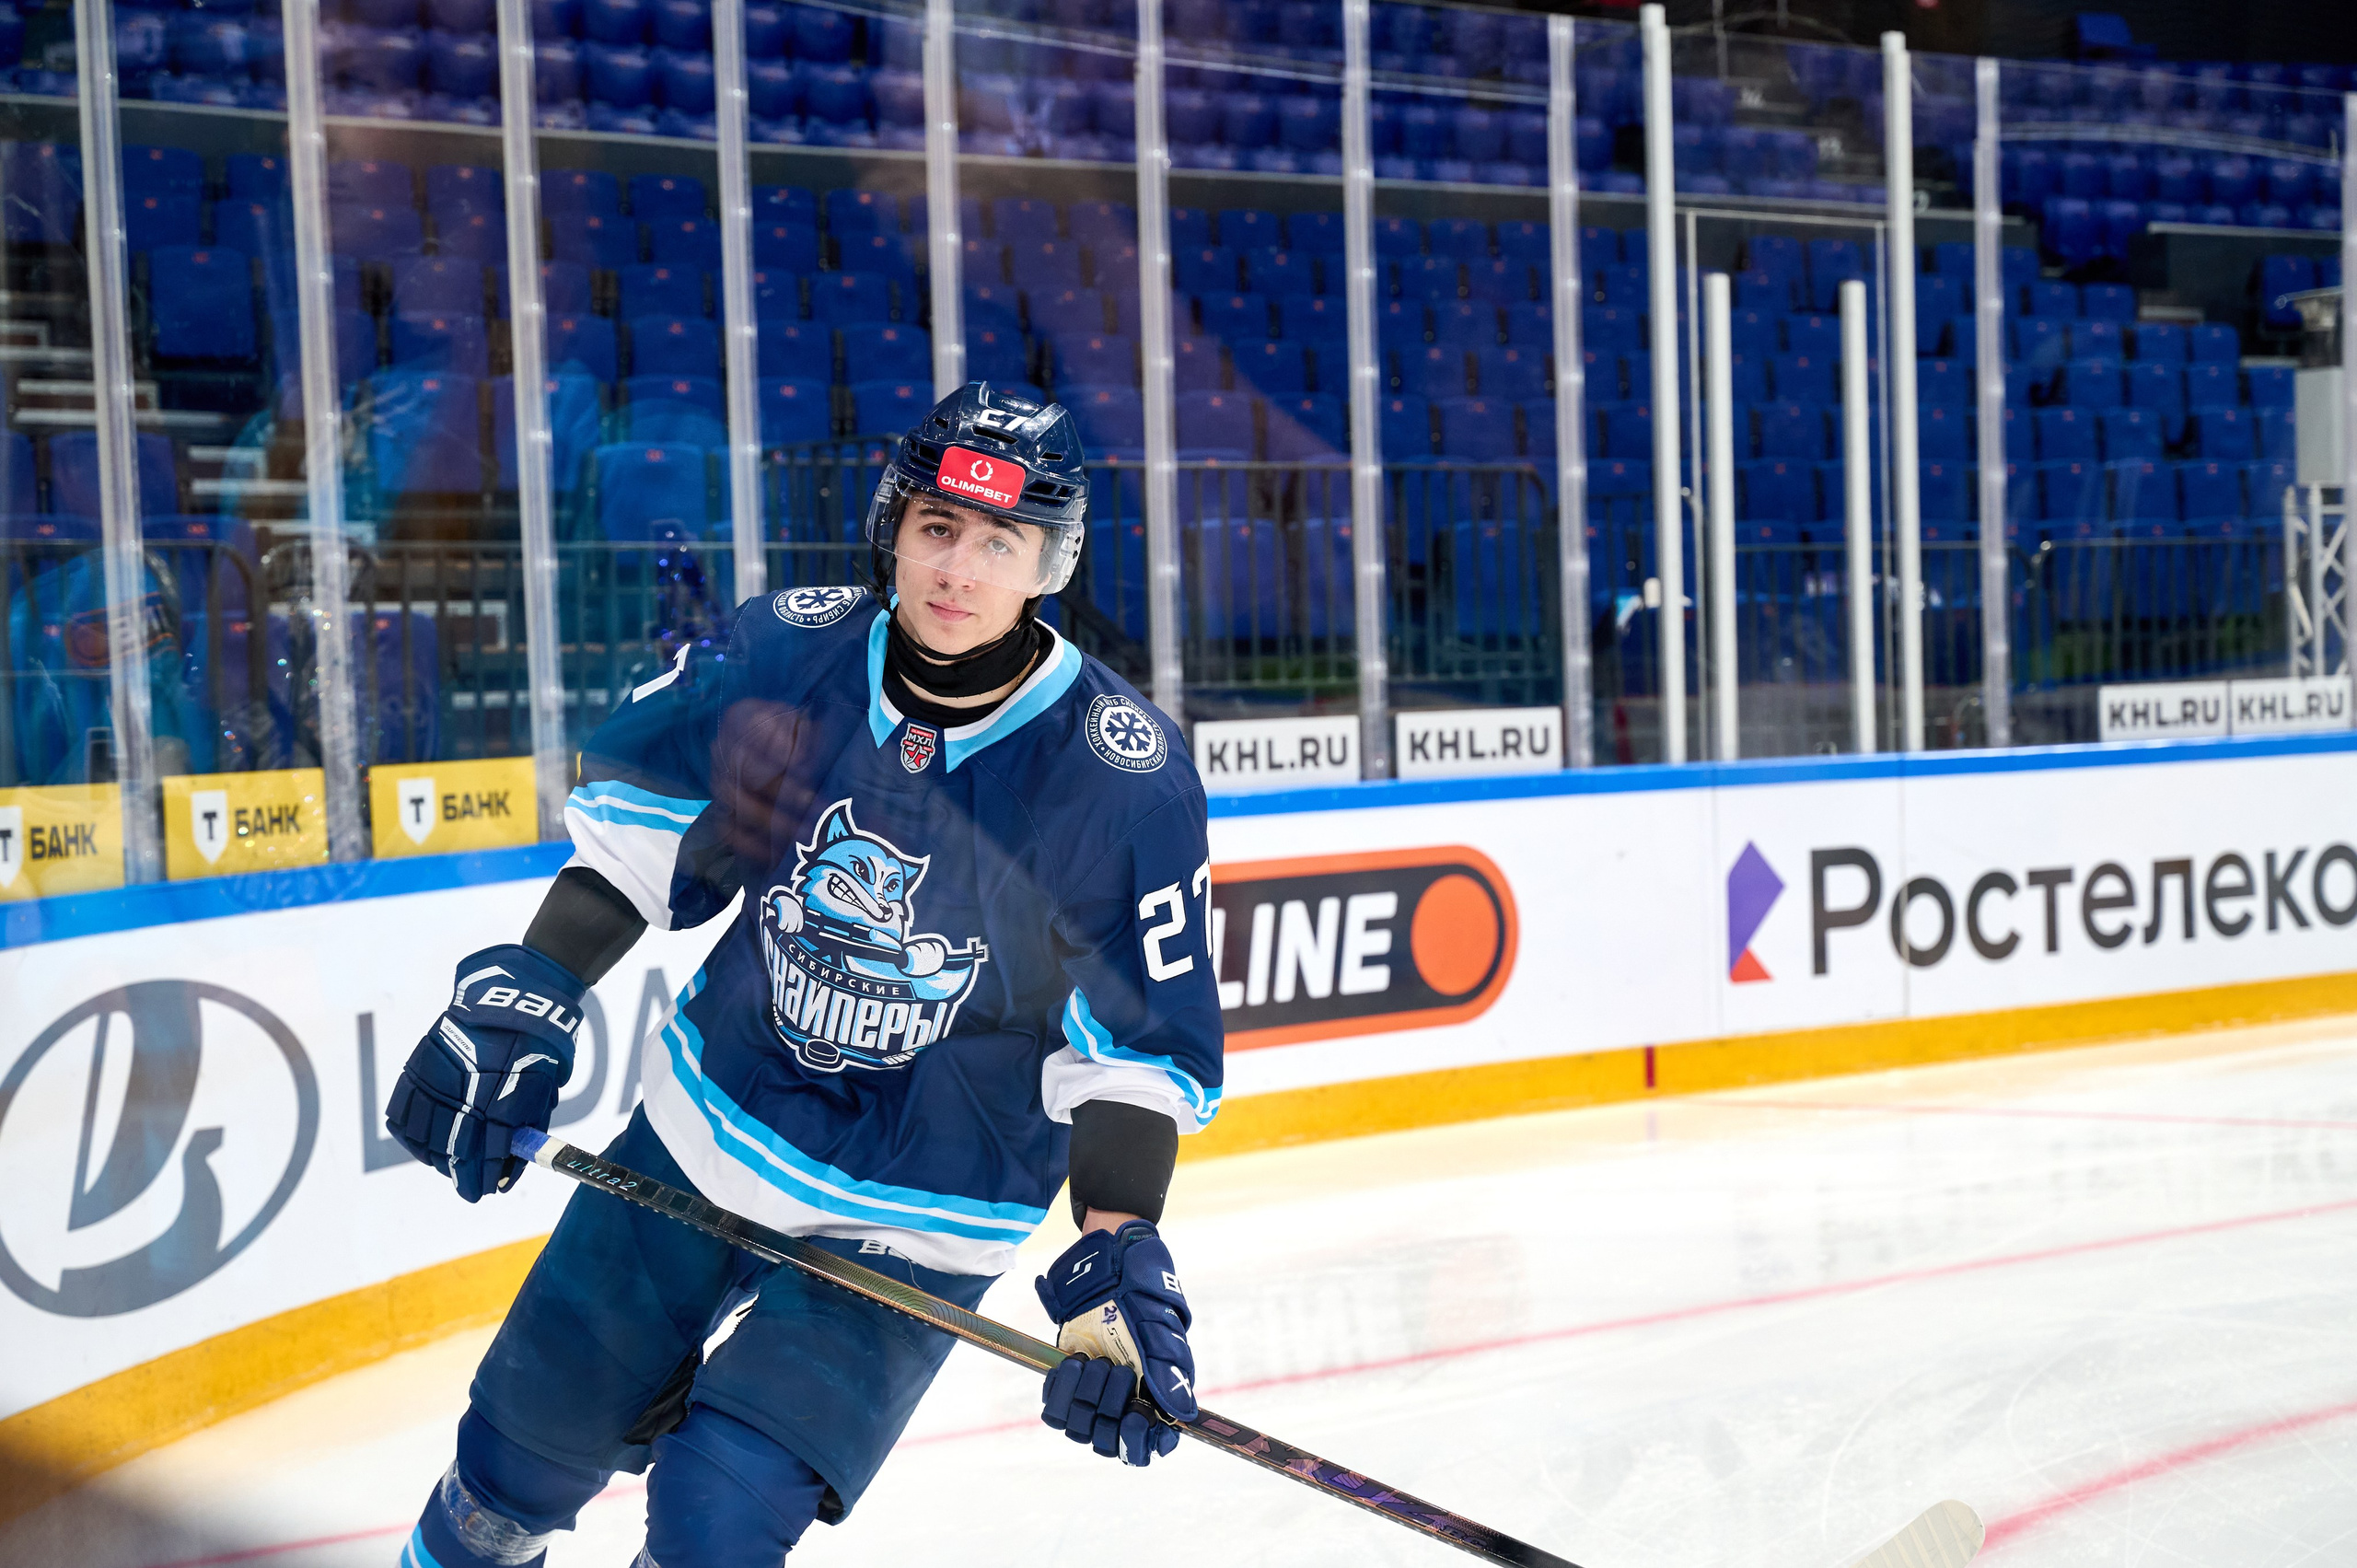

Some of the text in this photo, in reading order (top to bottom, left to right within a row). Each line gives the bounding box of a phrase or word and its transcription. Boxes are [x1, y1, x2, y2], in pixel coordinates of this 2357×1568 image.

[941, 475, 1012, 504] OLIMPBET
[1088, 698, 1107, 748] ХОККЕЙНЫЙ
[2109, 698, 2221, 729] KHL.RU
[2237, 692, 2344, 722] KHL.RU
[908, 733, 933, 747] МХЛ
[1208, 736, 1348, 774] KHL.RU
[1409, 726, 1550, 762] KHL.RU
[1104, 748, 1164, 770] НОВОСИБИРСКАЯ
[235, 804, 302, 839] БАНК
[442, 790, 511, 822] БАНК
[29, 822, 99, 861] БАНК
[1808, 842, 2357, 978] Ростелеко
[1212, 891, 1399, 1011] LINE
[788, 943, 900, 996] СИБИРСКИЕ
[443, 1025, 472, 1052] SUPREME
[566, 1159, 638, 1191] ultra2
